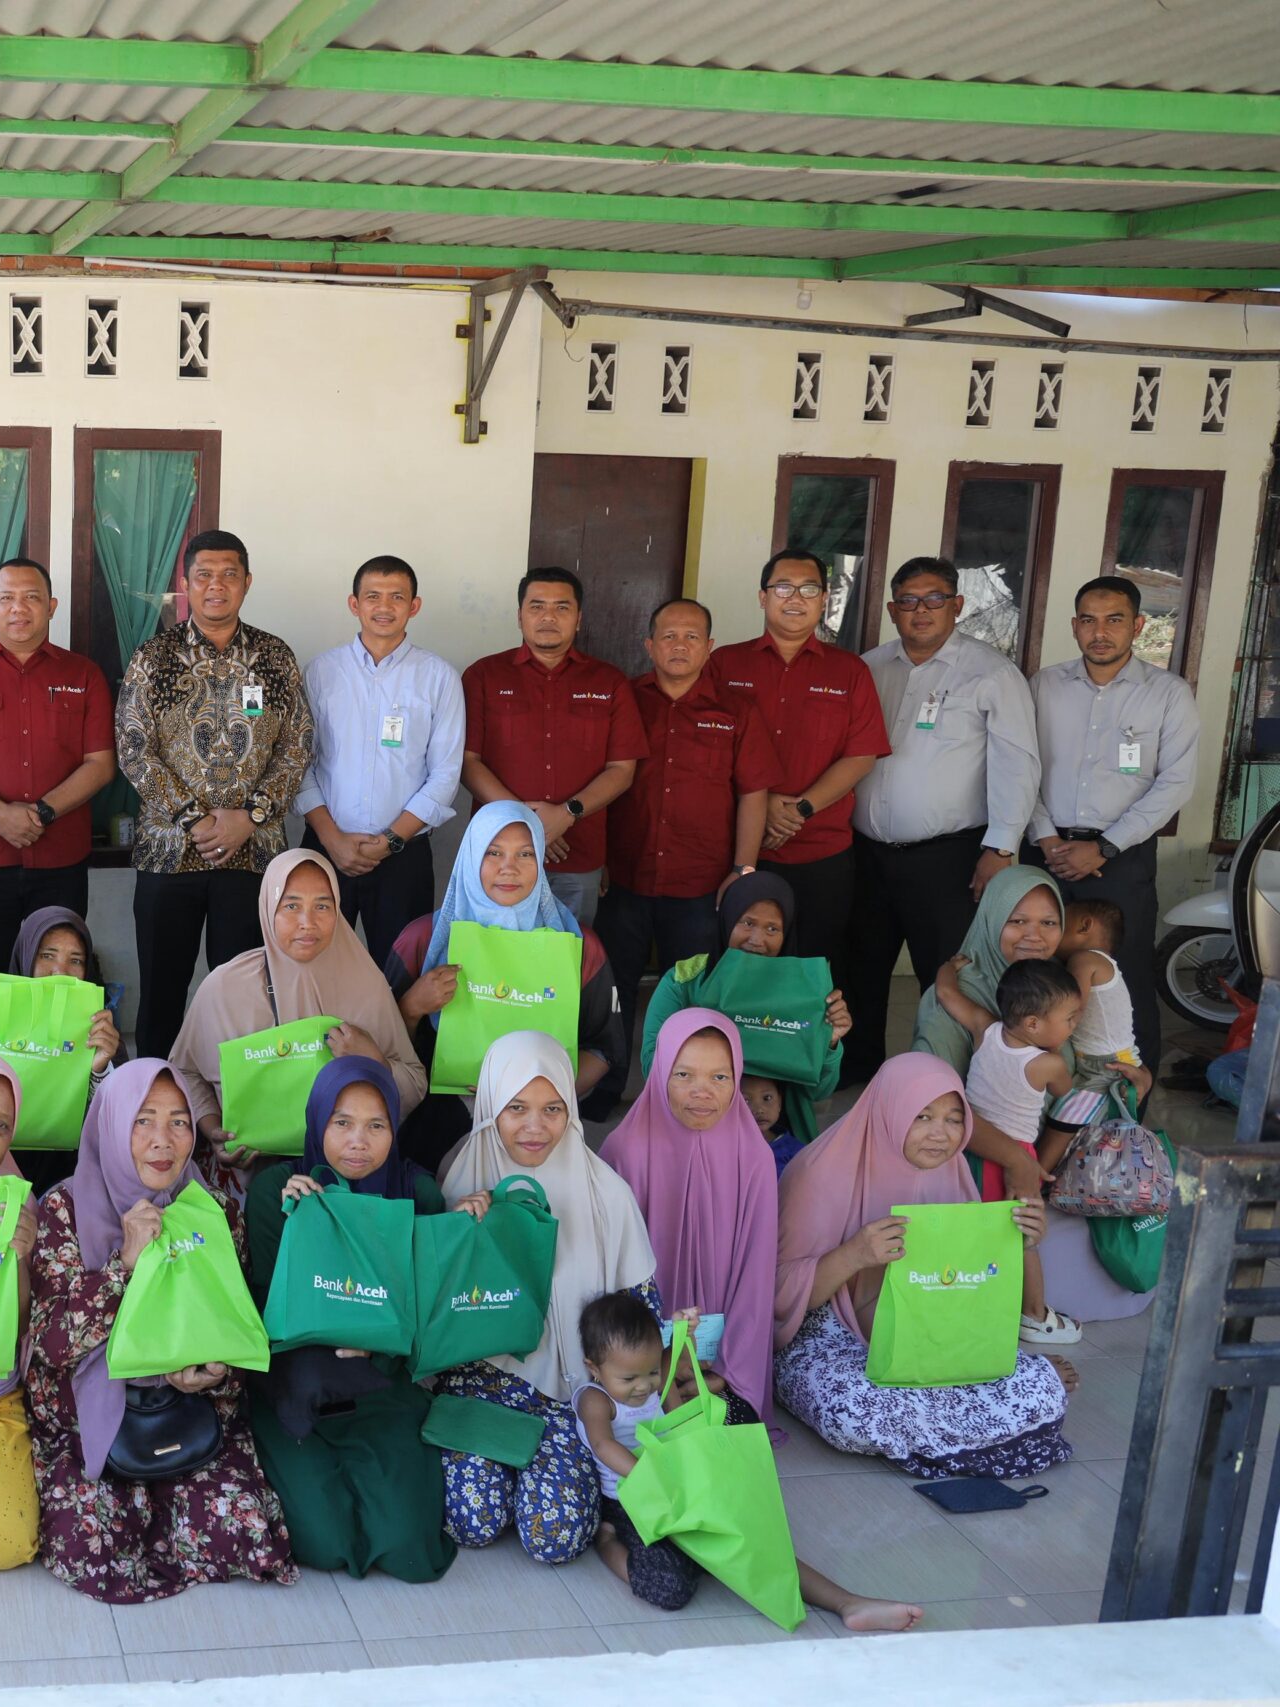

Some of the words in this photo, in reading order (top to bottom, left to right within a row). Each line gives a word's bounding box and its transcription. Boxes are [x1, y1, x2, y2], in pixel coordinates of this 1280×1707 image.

[509, 988, 543, 1003] Aceh
[734, 1014, 761, 1025] Bank
[773, 1018, 801, 1030] Aceh
[244, 1046, 276, 1060] Bank
[291, 1039, 324, 1053] Aceh
[1132, 1214, 1159, 1232] Bank
[909, 1271, 940, 1284] Bank
[314, 1275, 344, 1293] Bank
[356, 1282, 388, 1299] Aceh
[483, 1289, 513, 1303] Aceh
